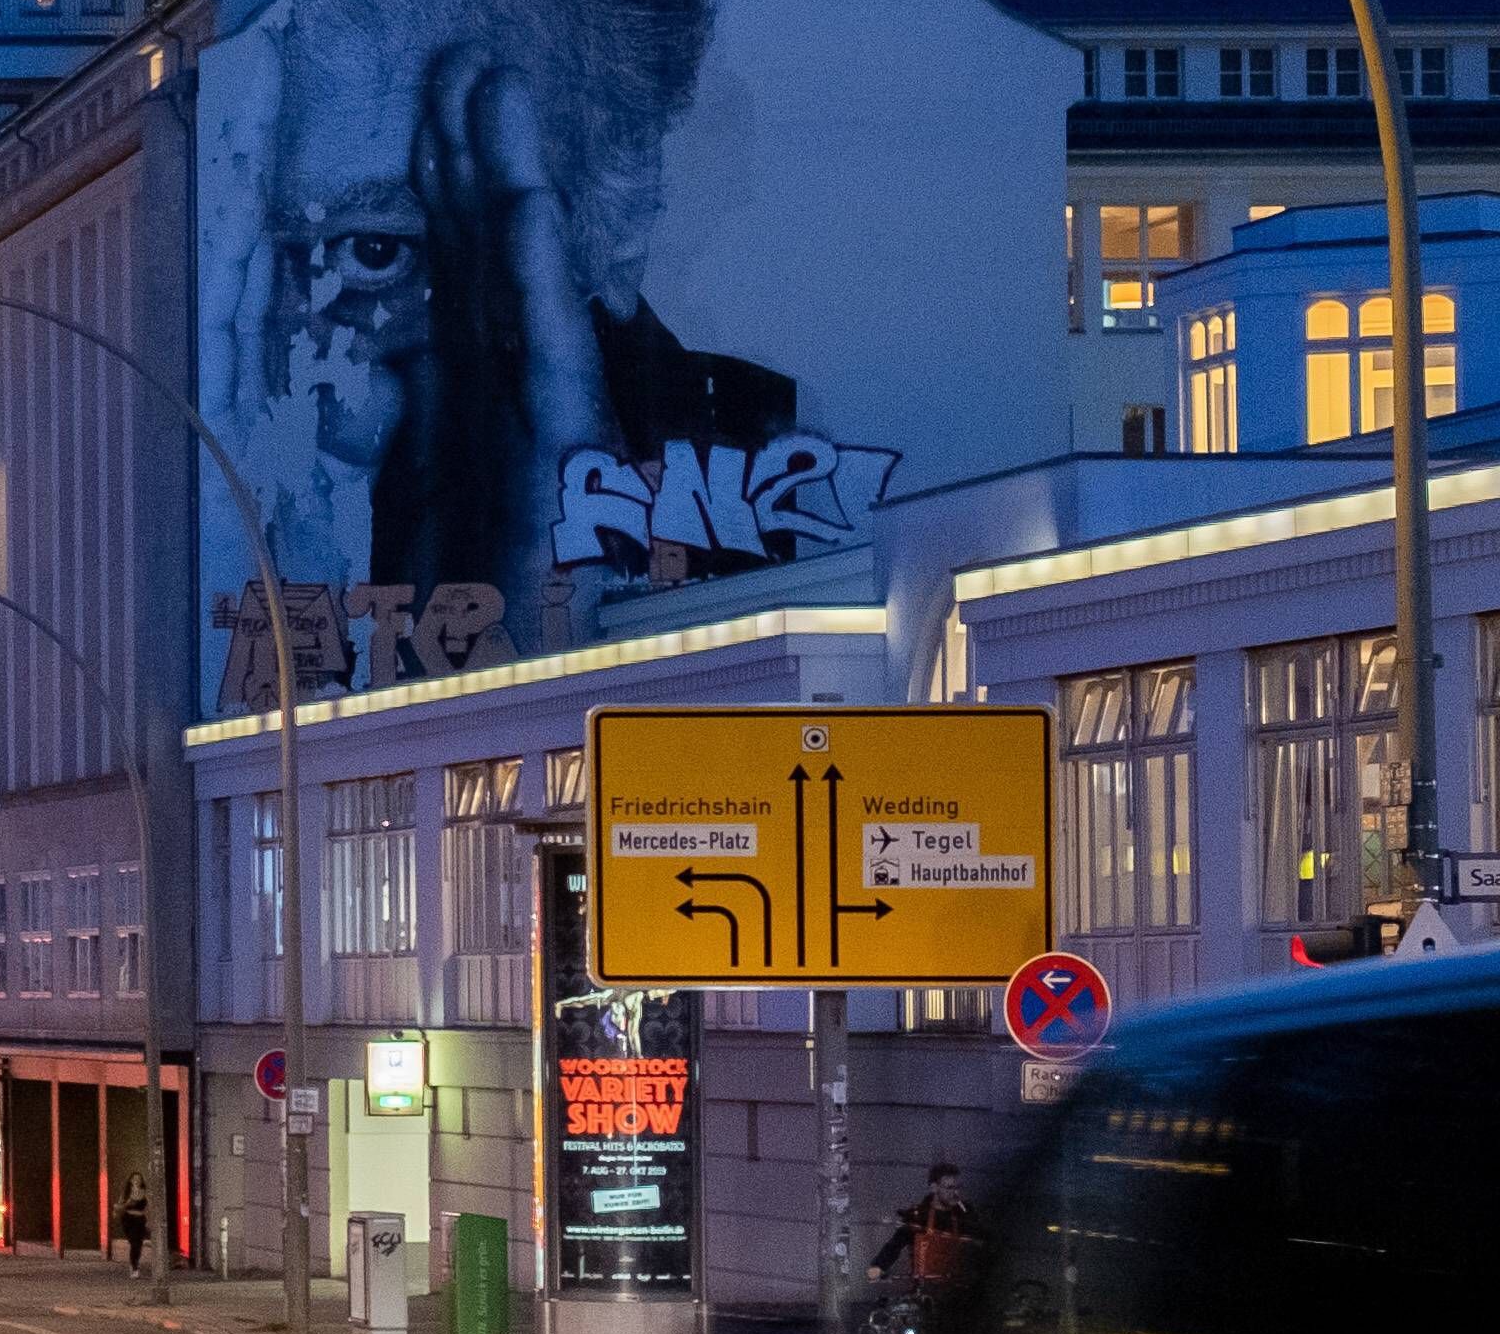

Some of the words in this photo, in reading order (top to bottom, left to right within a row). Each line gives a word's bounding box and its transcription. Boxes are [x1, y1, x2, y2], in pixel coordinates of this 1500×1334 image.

[610, 796, 771, 816] Friedrichshain
[862, 796, 959, 819] Wedding
[618, 831, 750, 850] Mercedes-Platz
[912, 830, 972, 854] Tegel
[567, 874, 587, 892] WI
[911, 862, 1028, 886] Hauptbahnhof
[559, 1058, 688, 1076] WOODSTOCK
[560, 1076, 688, 1102] VARIETY
[566, 1102, 682, 1135] SHOW
